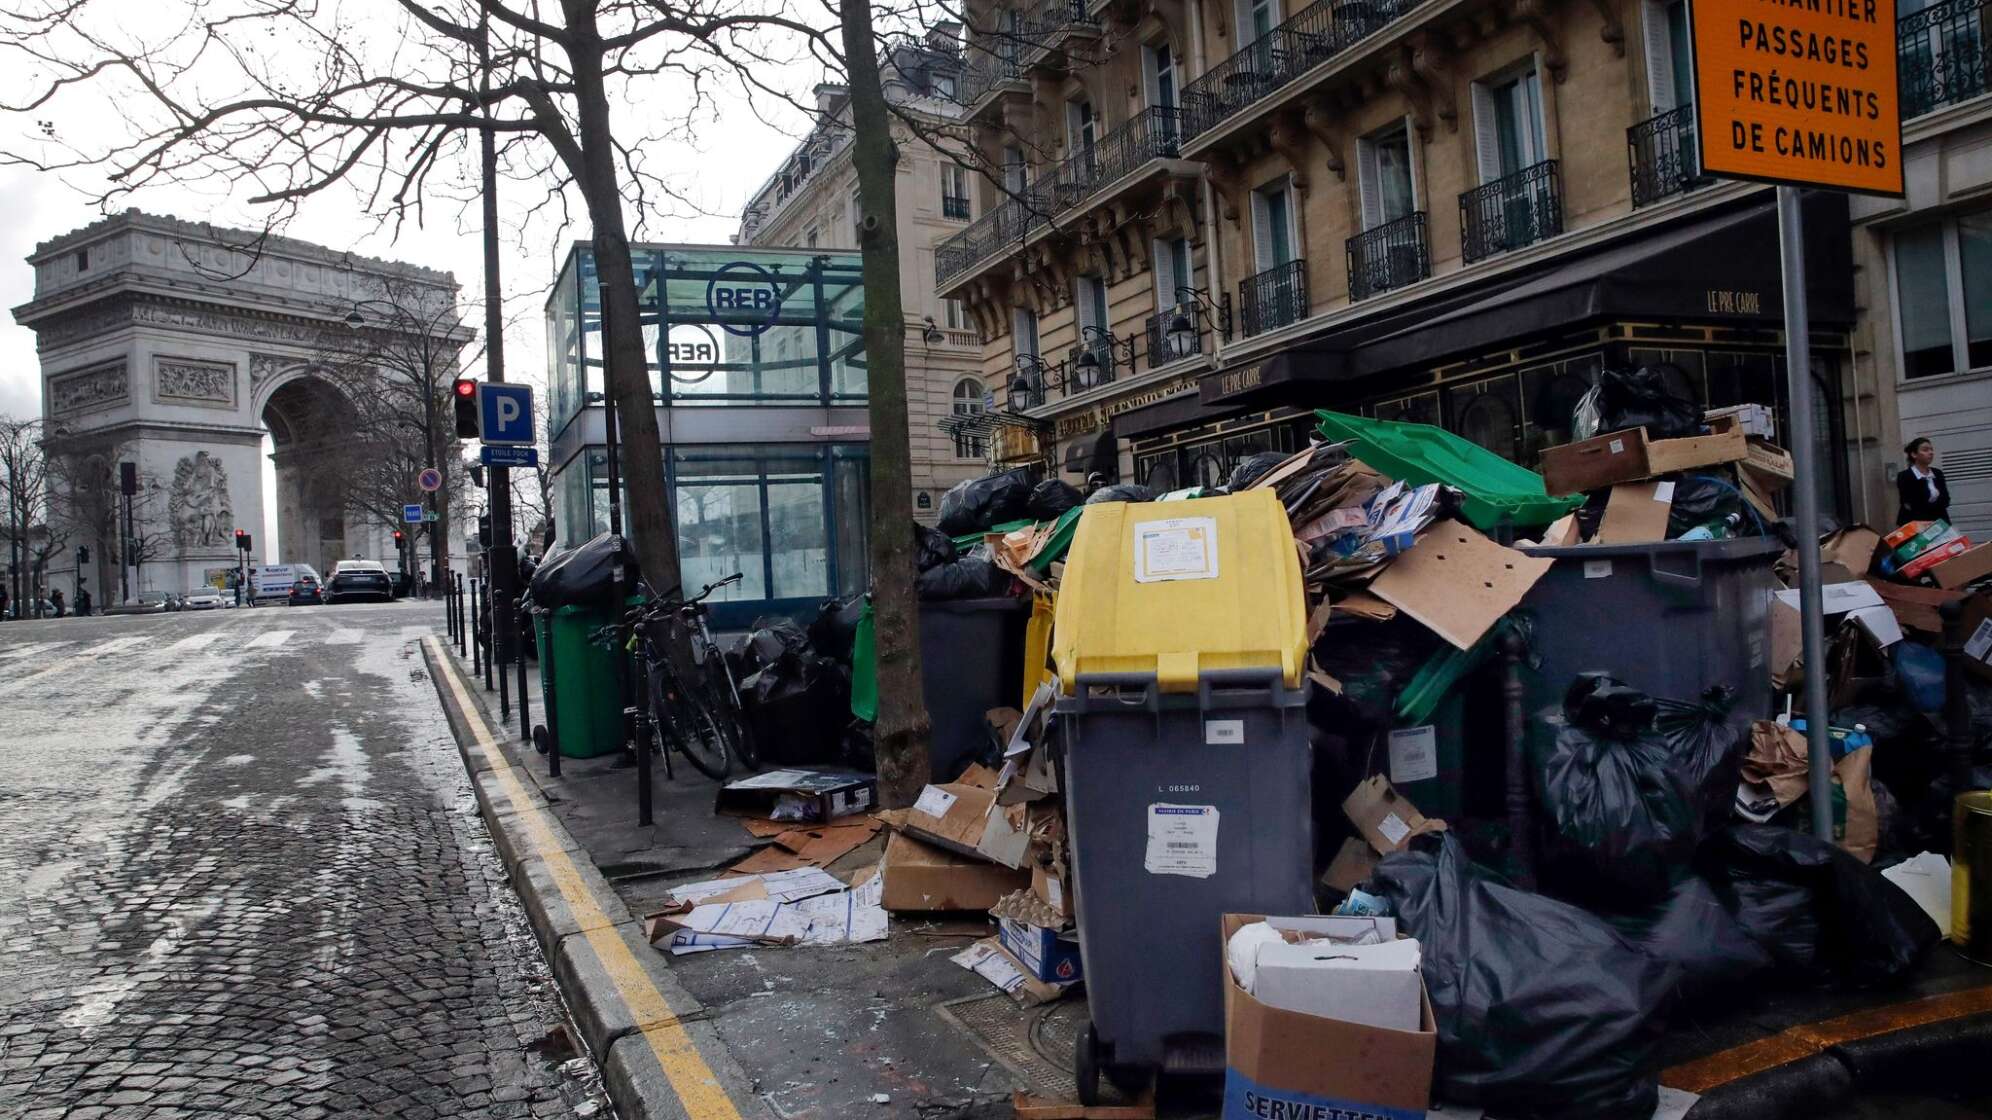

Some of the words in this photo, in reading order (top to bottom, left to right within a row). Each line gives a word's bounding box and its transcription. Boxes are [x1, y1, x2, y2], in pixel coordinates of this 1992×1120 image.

[1759, 0, 1877, 24] TIER
[1739, 19, 1869, 70] PASSAGES
[1733, 69, 1879, 120] FRÉQUENTS
[1732, 120, 1765, 153] DE
[1775, 126, 1886, 168] CAMIONS
[715, 287, 773, 310] RER
[1706, 290, 1717, 313] LE
[496, 395, 520, 432] P
[1245, 1091, 1393, 1120] SERVIET
